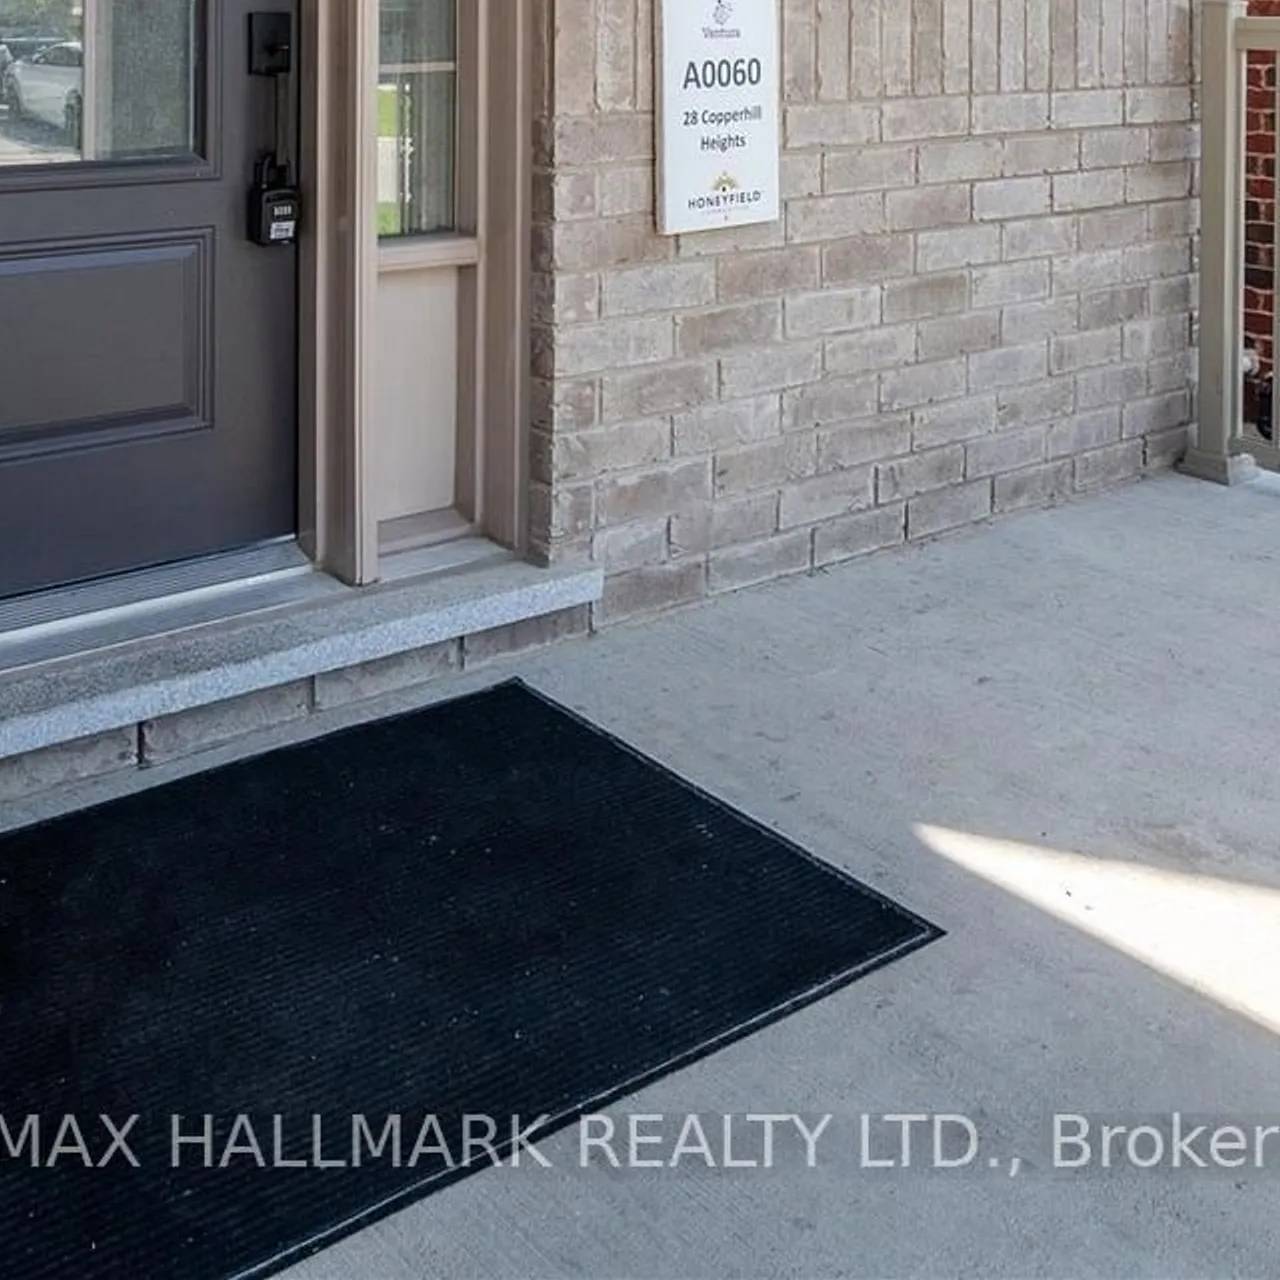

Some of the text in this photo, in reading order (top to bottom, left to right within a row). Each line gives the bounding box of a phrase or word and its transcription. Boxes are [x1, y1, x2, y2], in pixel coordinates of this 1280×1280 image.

[683, 57, 762, 90] A0060
[683, 105, 762, 126] 28 Copperhill
[700, 134, 746, 153] Heights
[687, 190, 761, 210] HONEYFIELD
